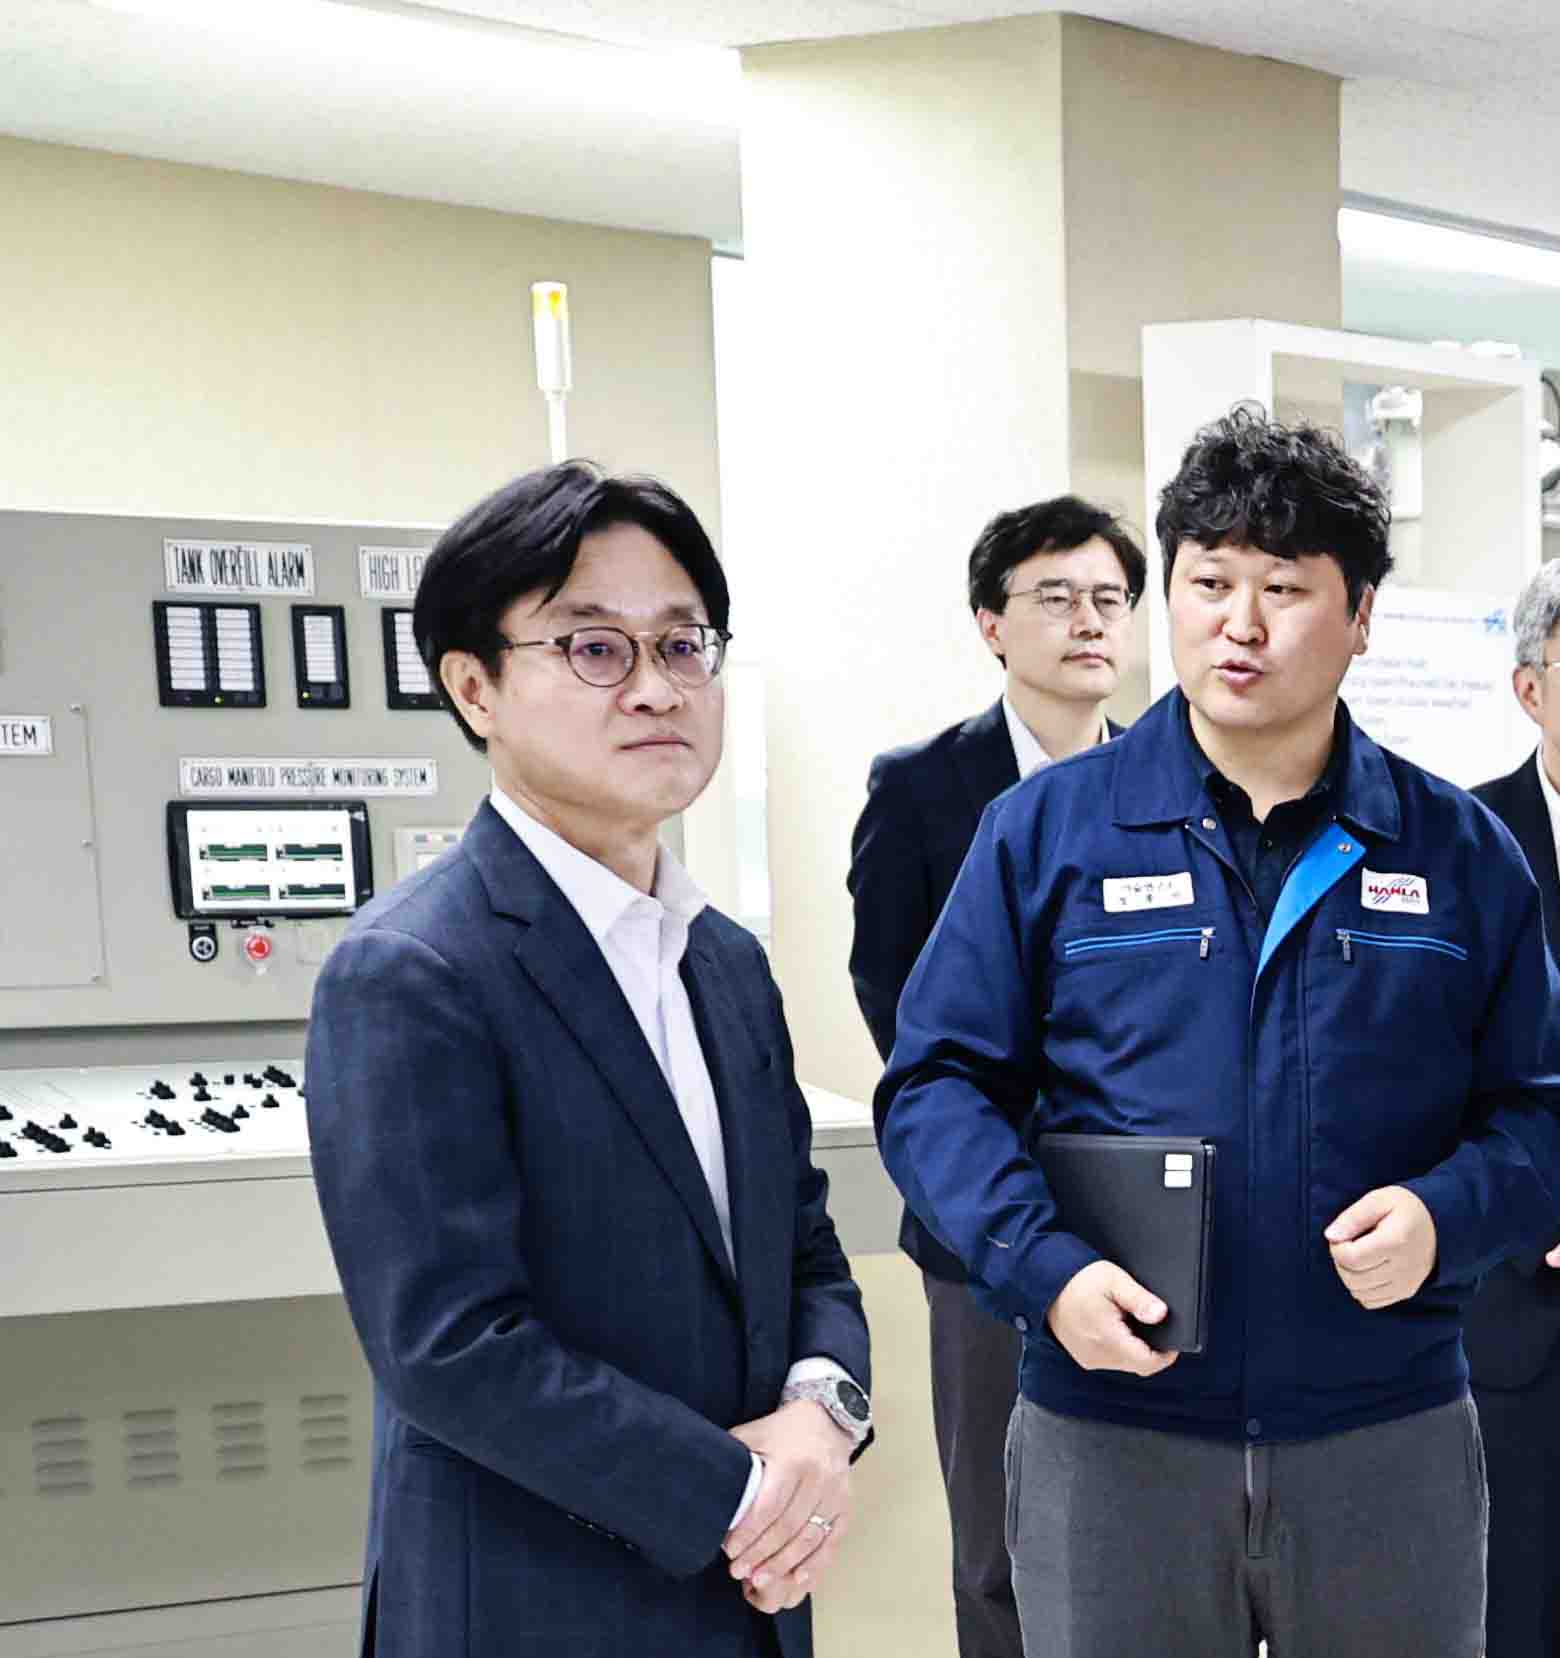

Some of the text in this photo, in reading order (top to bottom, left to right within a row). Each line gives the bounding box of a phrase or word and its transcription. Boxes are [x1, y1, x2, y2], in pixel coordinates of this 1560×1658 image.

[175, 546, 306, 588] TANK OVERFILL ALARM
[368, 553, 401, 593] HIGH
[190, 766, 223, 788] CARGO
[227, 766, 275, 788] MANIFOLD
[279, 766, 327, 788] PRESSURE
[392, 766, 428, 788] SYSTEM
